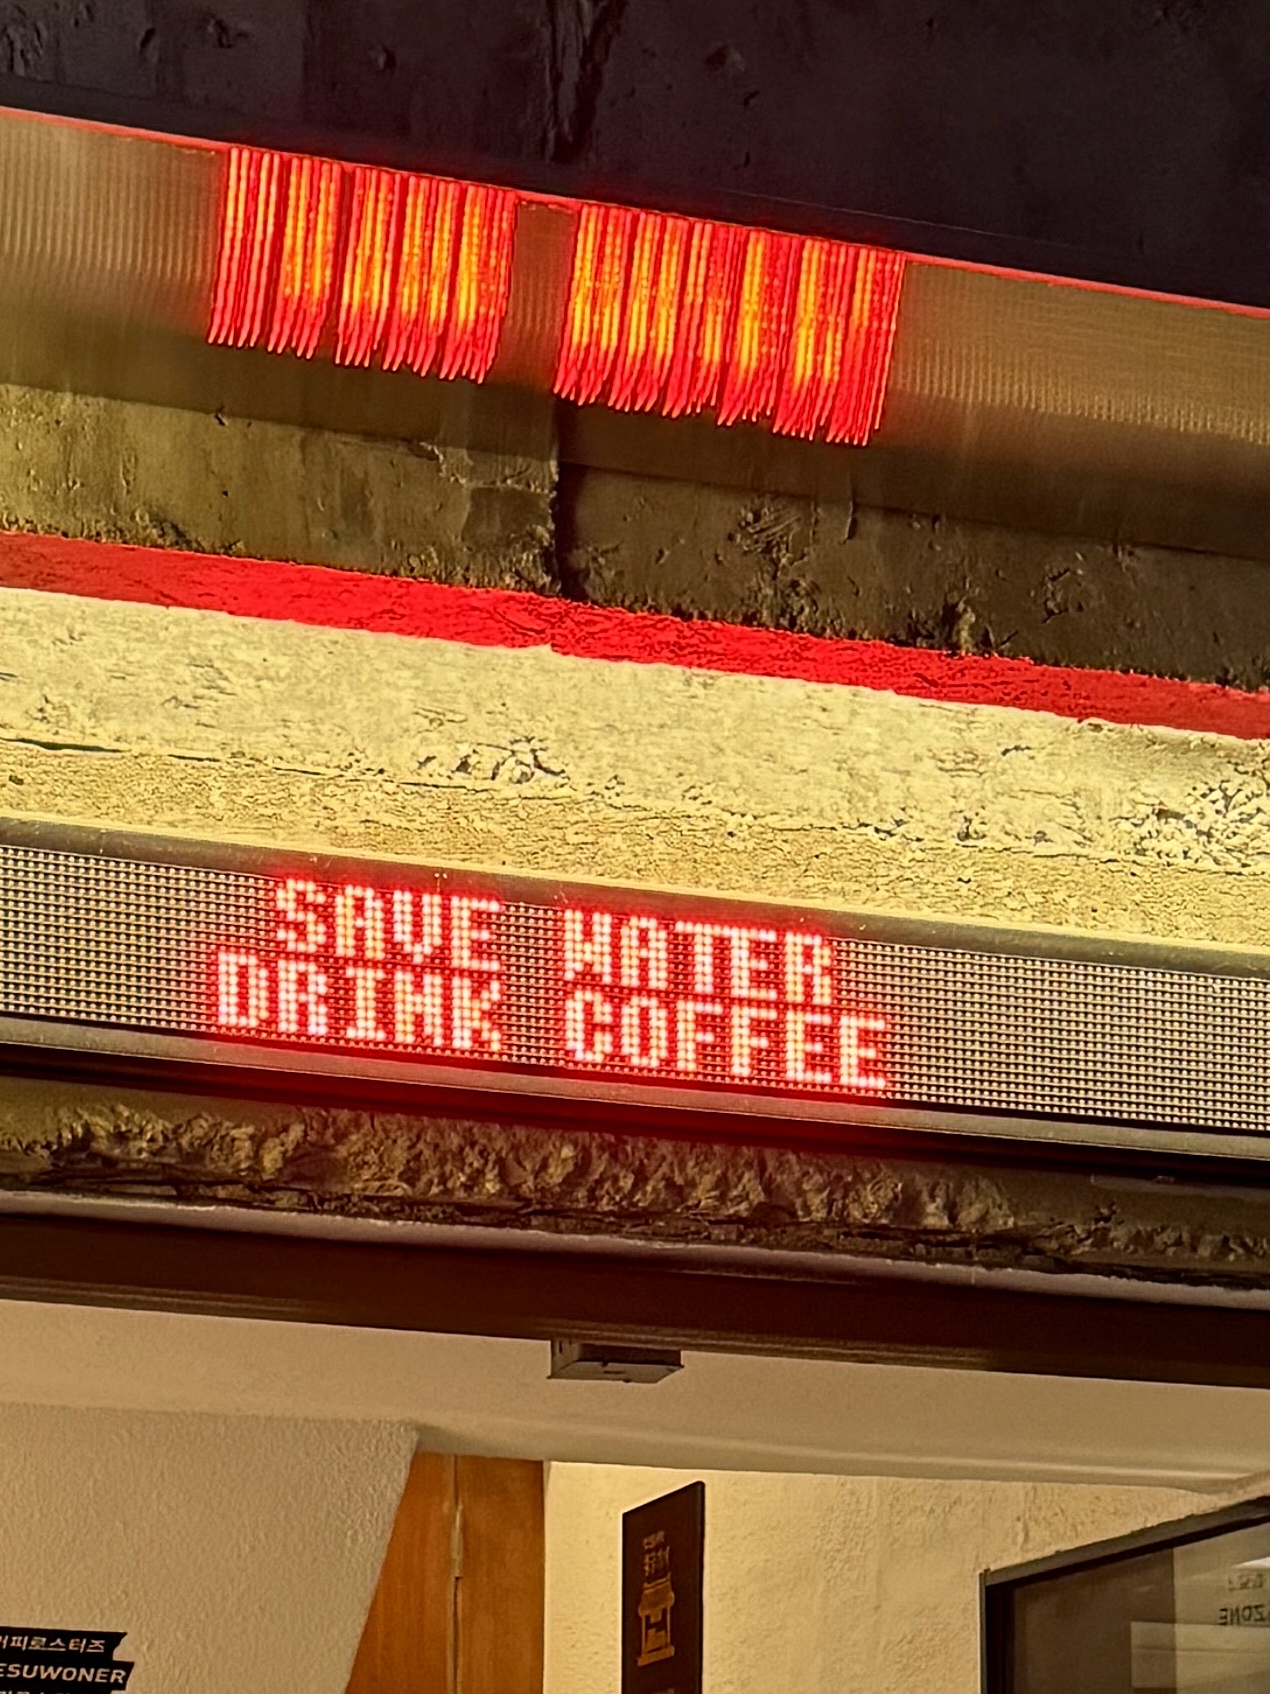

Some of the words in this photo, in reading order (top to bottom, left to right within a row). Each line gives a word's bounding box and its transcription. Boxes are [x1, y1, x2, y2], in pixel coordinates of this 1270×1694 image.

[274, 878, 506, 974] SAVE
[561, 906, 834, 1006] WATER
[215, 950, 504, 1054] DRINK
[563, 986, 892, 1091] COFFEE
